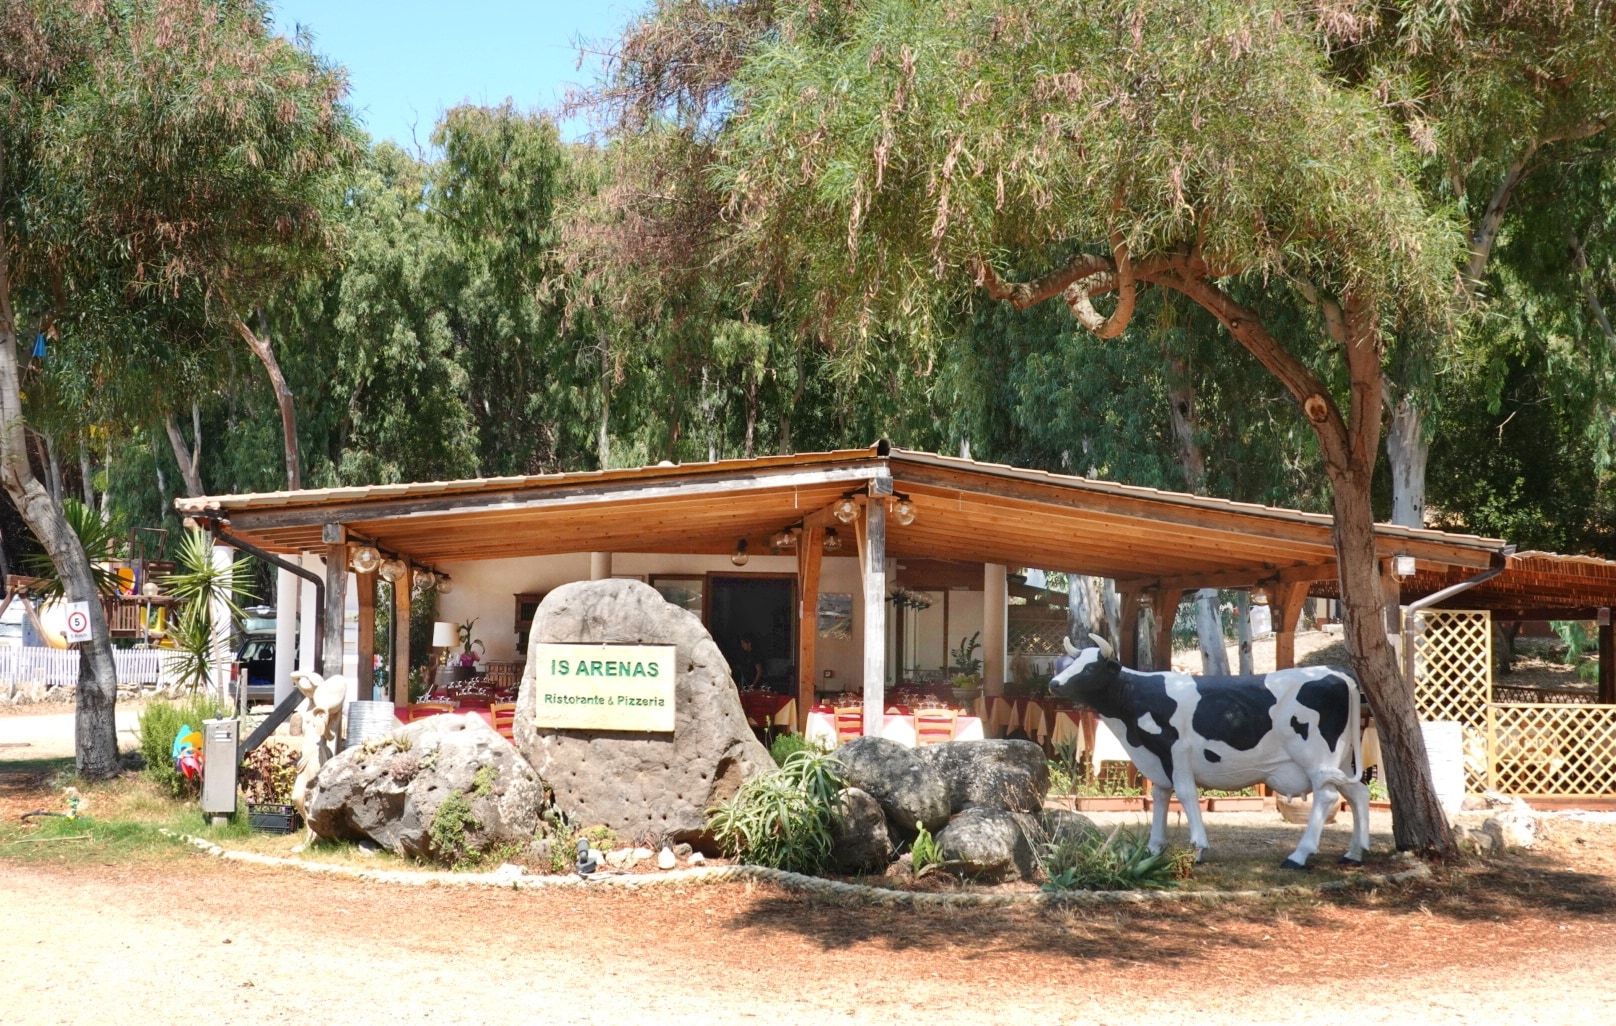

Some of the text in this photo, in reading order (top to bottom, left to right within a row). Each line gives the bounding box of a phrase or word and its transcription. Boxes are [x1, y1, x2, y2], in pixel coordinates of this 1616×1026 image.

[74, 617, 80, 627] 5
[551, 659, 660, 677] IS ARENAS
[544, 693, 665, 707] Ristorante & Pizzeria
